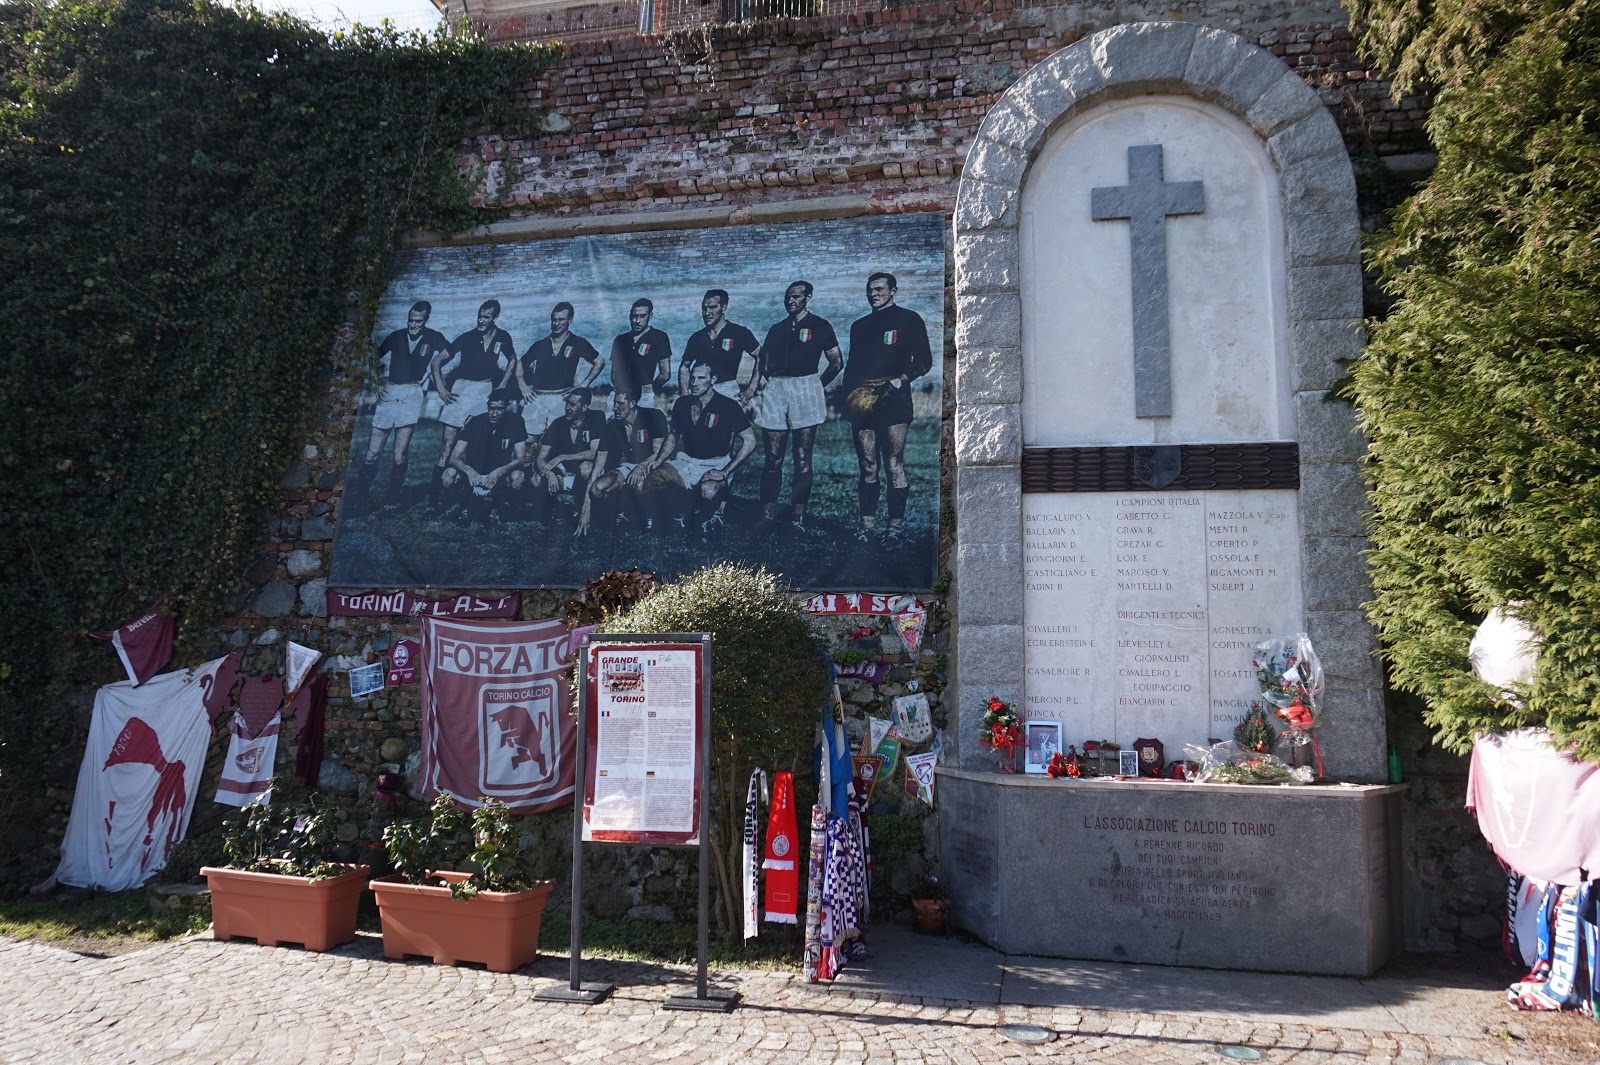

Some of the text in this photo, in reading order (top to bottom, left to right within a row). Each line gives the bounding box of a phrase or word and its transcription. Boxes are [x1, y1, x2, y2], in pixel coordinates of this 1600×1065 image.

[1121, 498, 1166, 507] CAMPIONI
[1169, 498, 1201, 506] D'ITALIA
[1208, 512, 1254, 520] MAZZOLA
[1026, 528, 1066, 536] BALLARIN
[1209, 526, 1238, 534] MENTI
[1210, 540, 1248, 548] OPERTO
[1026, 555, 1076, 563] BONGIORNI
[1210, 554, 1250, 562] OSSOLA
[1026, 569, 1087, 577] CASTIGLIANO
[1026, 583, 1053, 591] FADINI
[1211, 583, 1245, 591] SUBERT
[338, 592, 405, 613] TORINO
[1117, 611, 1159, 619] DIRIGENTI
[1169, 611, 1205, 619] TECNICI
[1212, 627, 1261, 635] AGNISETTA
[1118, 640, 1164, 648] LIEVESLEY
[1212, 641, 1251, 649] CORTINA
[438, 640, 531, 675] FORZA
[1119, 669, 1170, 677] CAVALLERO
[1213, 670, 1252, 678] TOSATTI
[1133, 683, 1191, 692] EQUIPAGGIO
[488, 687, 550, 700] TORINO CALCIO
[1120, 698, 1165, 706] BIANCIARDI
[1027, 710, 1054, 718] D'INCA
[1084, 815, 1275, 836] L'ASSOCIAZIONE CALCIO TORINO
[1134, 839, 1224, 852] A PERENNE RICORDO
[1138, 853, 1222, 866] DEI SUOI CAMPIONI
[1145, 867, 1172, 878] DELLO
[1176, 868, 1204, 879] SPORT
[1098, 878, 1107, 887] DI
[1110, 879, 1143, 889] COLORO
[1148, 881, 1163, 891] CHE
[1168, 882, 1184, 892] CON
[1188, 883, 1208, 893] ESSI
[1212, 885, 1227, 895] QUI
[1231, 885, 1275, 897] PERIRONO
[1113, 893, 1131, 903] PER
[1222, 899, 1251, 910] AEREA
[1165, 910, 1197, 920] MAGGIO
[1549, 902, 1578, 996] UNITED
